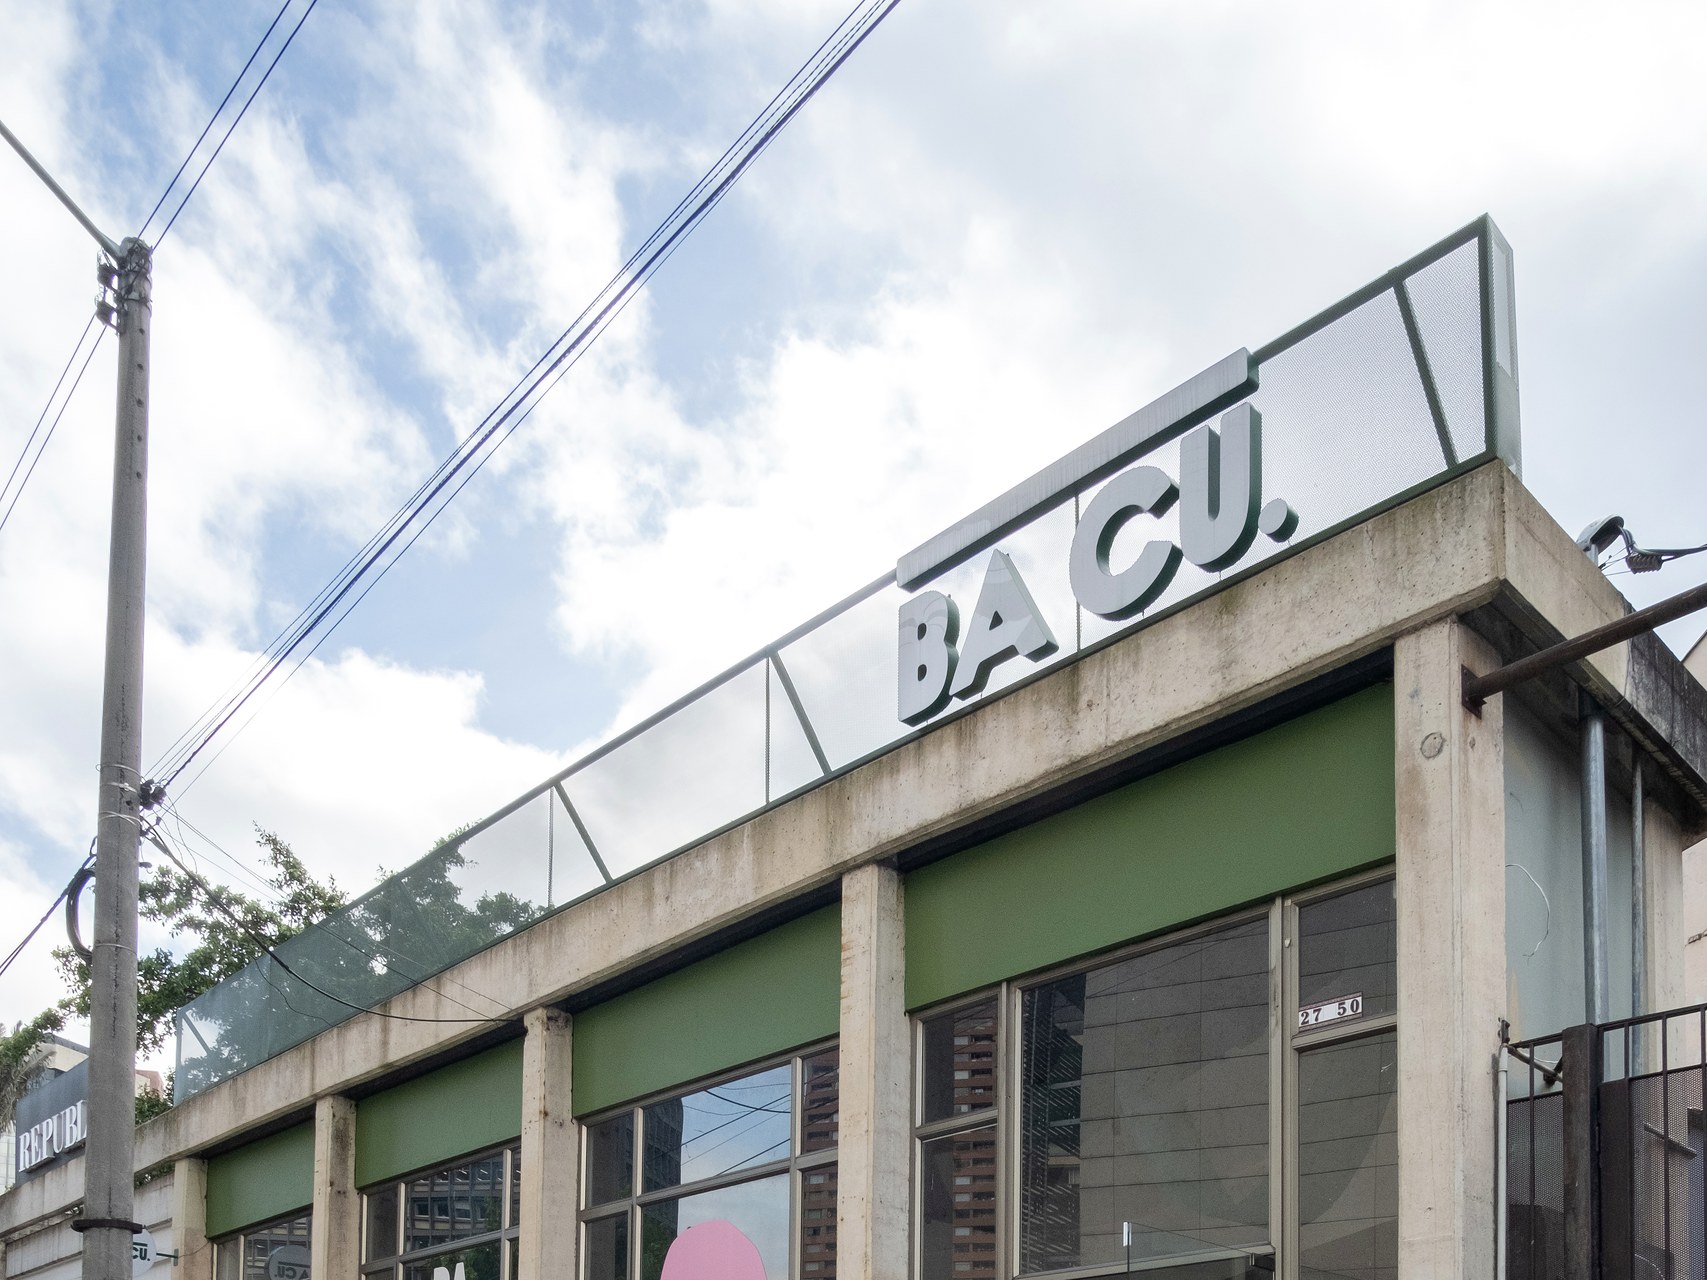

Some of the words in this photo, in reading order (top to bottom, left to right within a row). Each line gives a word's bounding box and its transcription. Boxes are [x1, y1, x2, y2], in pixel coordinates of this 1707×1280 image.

[1300, 1008, 1322, 1025] 27
[1337, 999, 1360, 1015] 50
[19, 1100, 87, 1172] REPUBL
[132, 1246, 150, 1262] CU.
